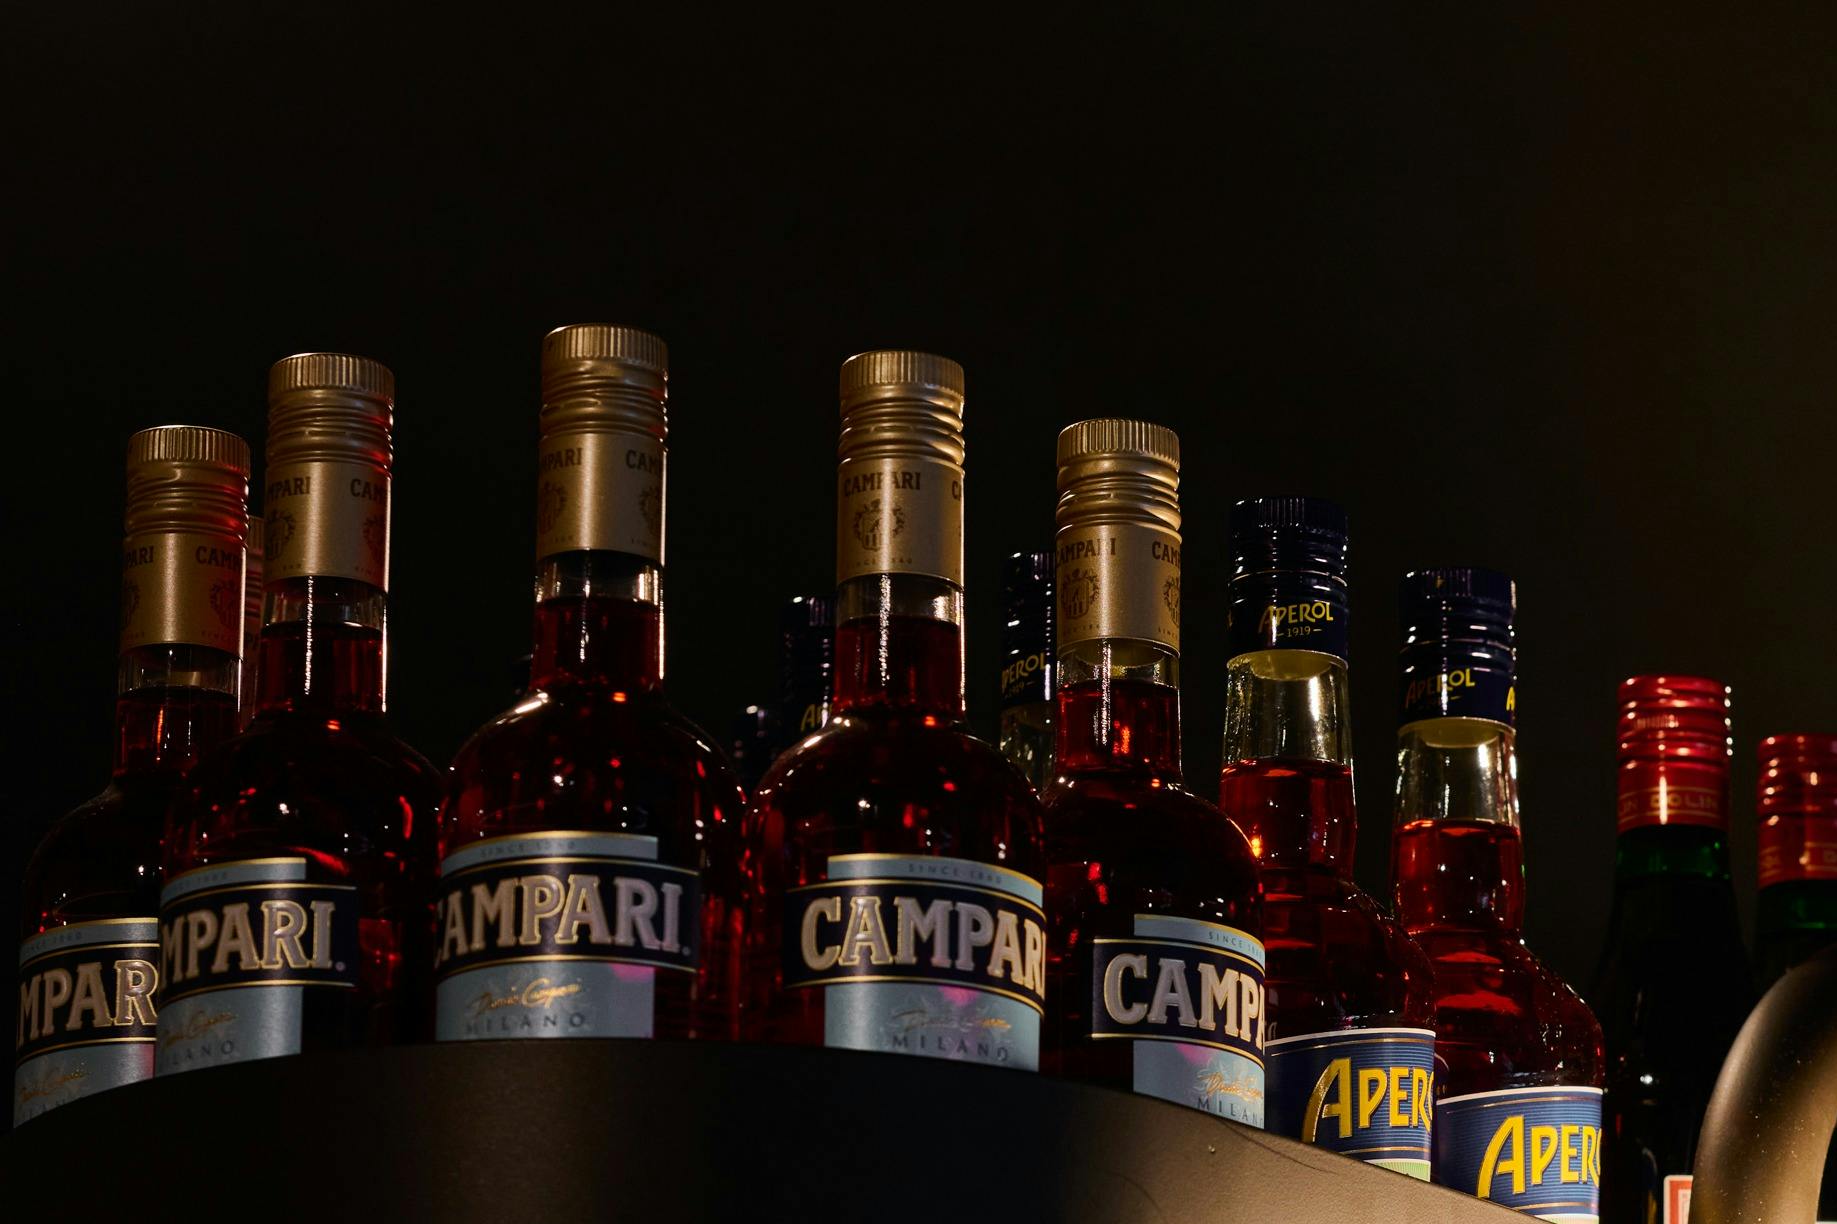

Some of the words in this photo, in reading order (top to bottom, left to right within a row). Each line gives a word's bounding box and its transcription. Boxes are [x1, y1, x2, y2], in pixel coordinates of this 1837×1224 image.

[1056, 537, 1117, 569] AMPAI
[1257, 600, 1335, 635] APEROL
[434, 873, 683, 970] AMPARI
[892, 1035, 1010, 1062] MILANO
